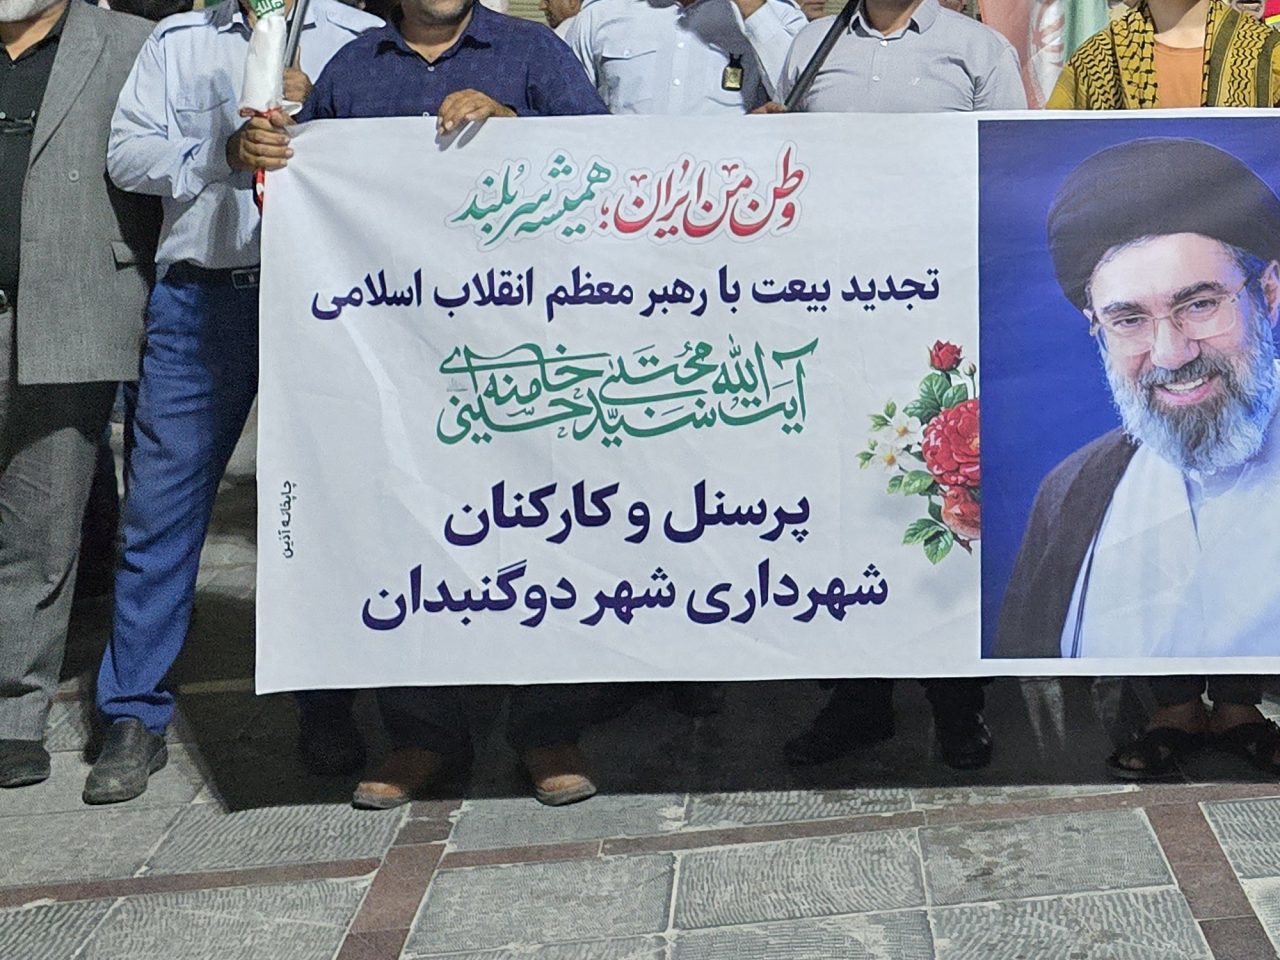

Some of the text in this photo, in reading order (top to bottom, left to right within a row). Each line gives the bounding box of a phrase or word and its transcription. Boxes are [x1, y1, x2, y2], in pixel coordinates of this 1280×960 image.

[513, 153, 613, 238] همیشه
[682, 162, 753, 238] من
[728, 145, 805, 237] وطن
[310, 264, 941, 323] تجدید بیعت با رهبر معظم انقلاب اسلامی
[280, 480, 297, 527] چاپخانه
[443, 478, 811, 547] پرسنل و کارکنان
[360, 557, 890, 632] شهرداری شهر دوگنبدان
